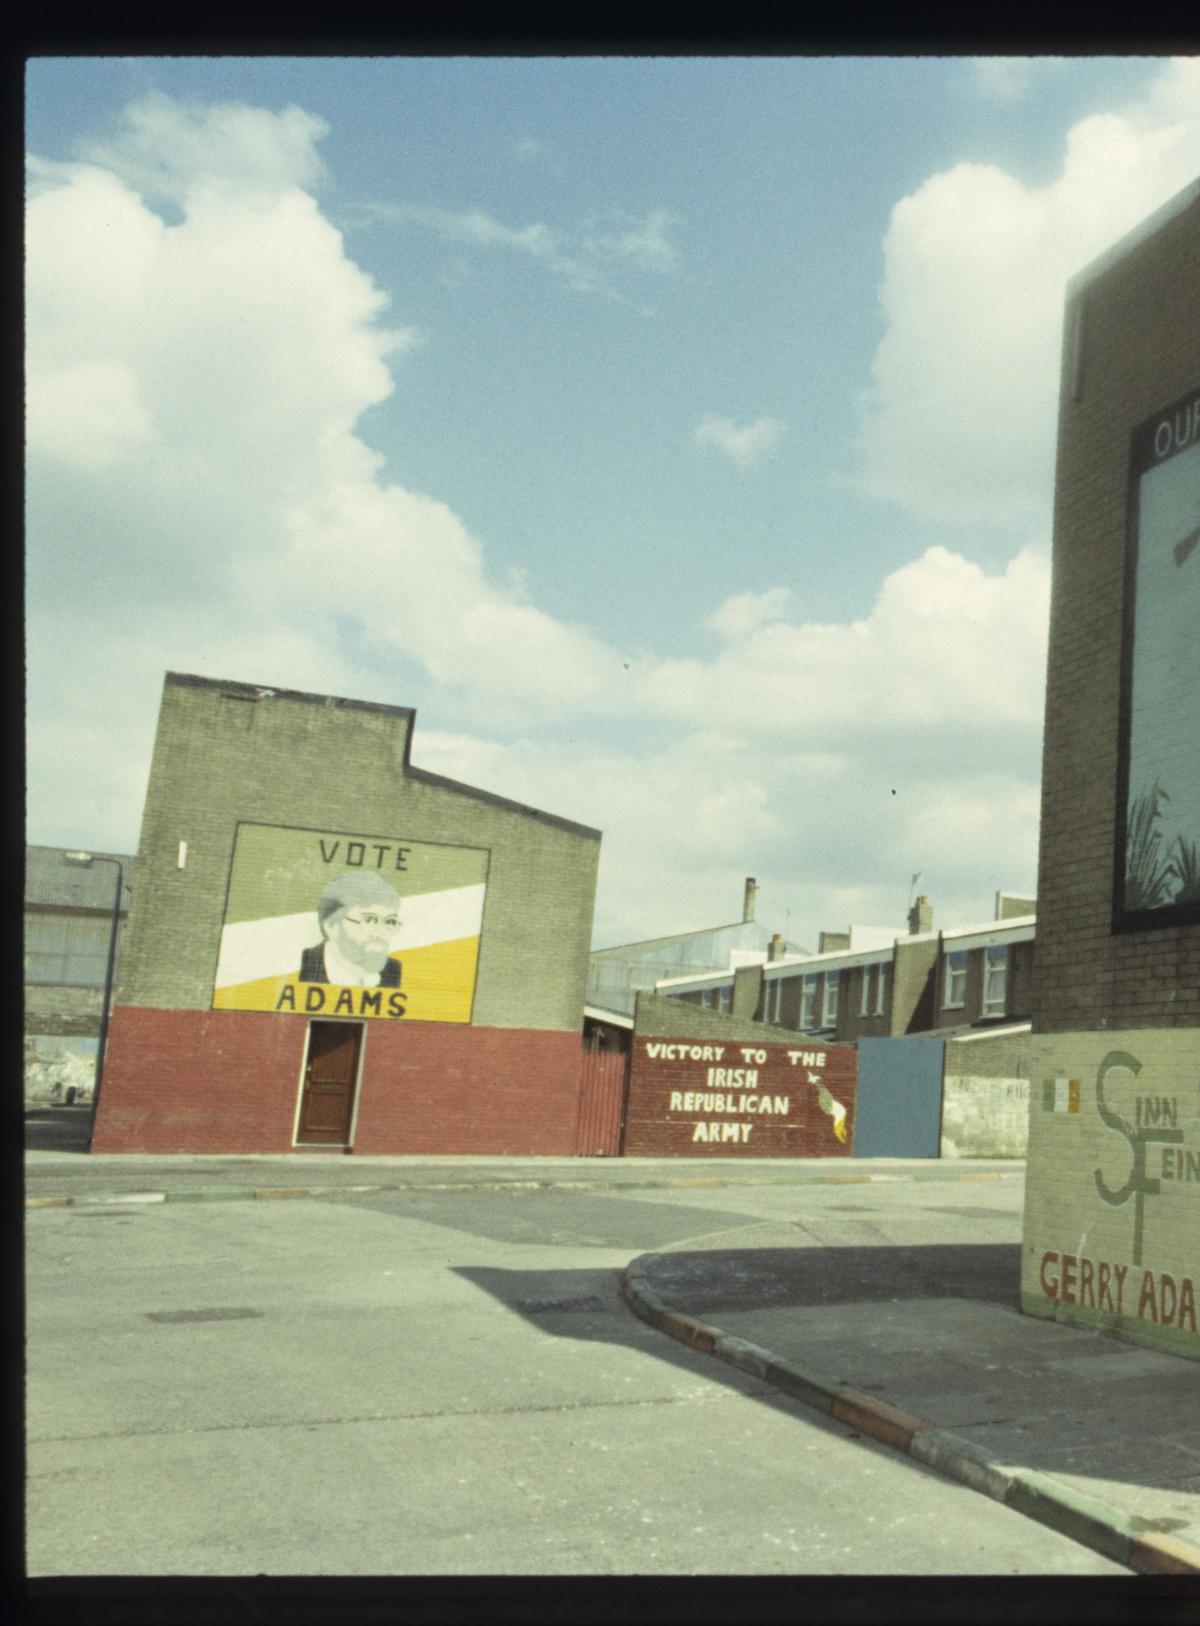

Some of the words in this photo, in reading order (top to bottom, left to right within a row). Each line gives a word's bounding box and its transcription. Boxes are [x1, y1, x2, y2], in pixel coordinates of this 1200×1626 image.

[319, 839, 411, 871] VOTE
[275, 984, 408, 1017] ADAMS
[646, 1043, 725, 1062] VICTORY
[740, 1048, 767, 1064] TO
[787, 1050, 827, 1067] THE
[707, 1067, 758, 1089] IRISH
[670, 1091, 790, 1115] REPUBLICAN
[692, 1121, 753, 1143] ARMY
[1040, 1251, 1129, 1315] GERRY
